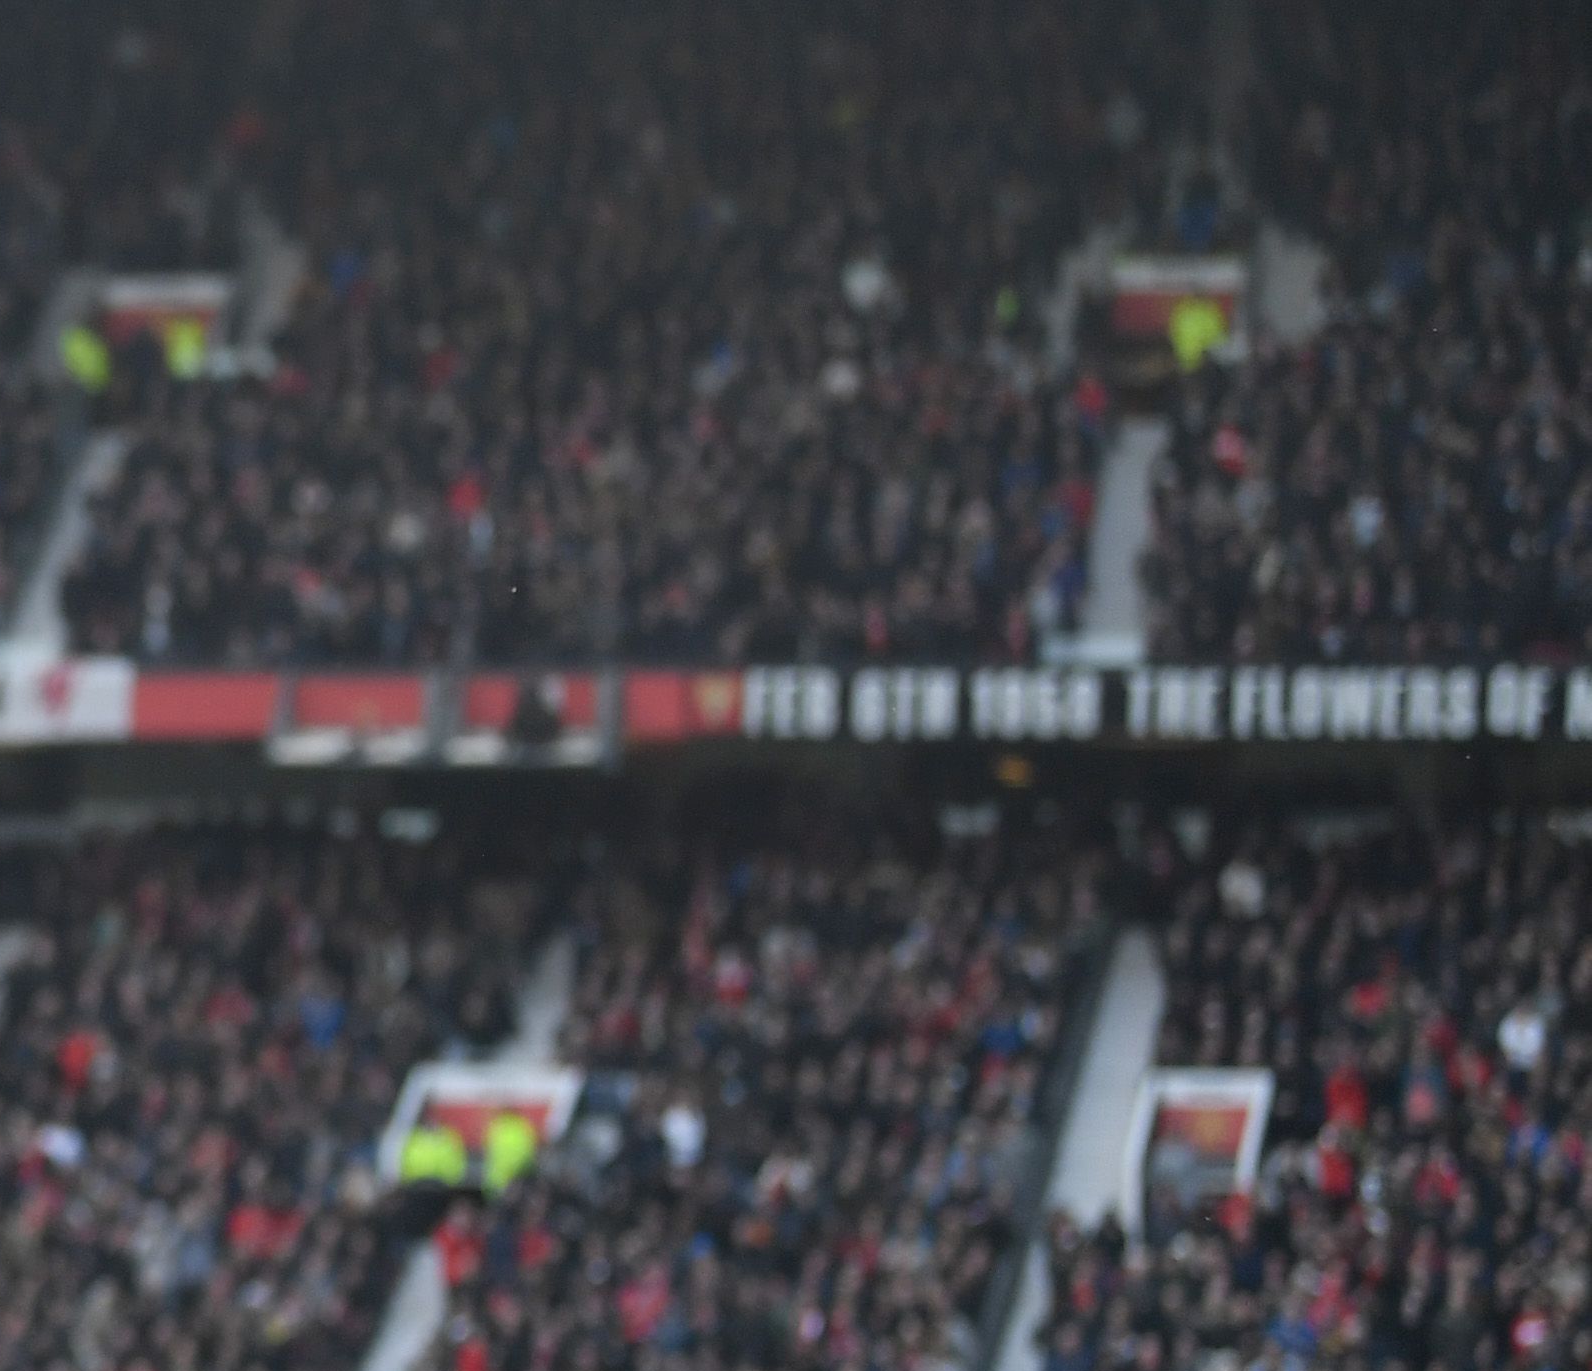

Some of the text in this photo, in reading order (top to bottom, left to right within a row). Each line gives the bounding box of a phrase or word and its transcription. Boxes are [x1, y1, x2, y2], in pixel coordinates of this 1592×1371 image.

[743, 664, 842, 741] FEB
[1123, 664, 1221, 741] THE
[1228, 663, 1480, 742] FLOWERS
[1484, 661, 1553, 740] OF
